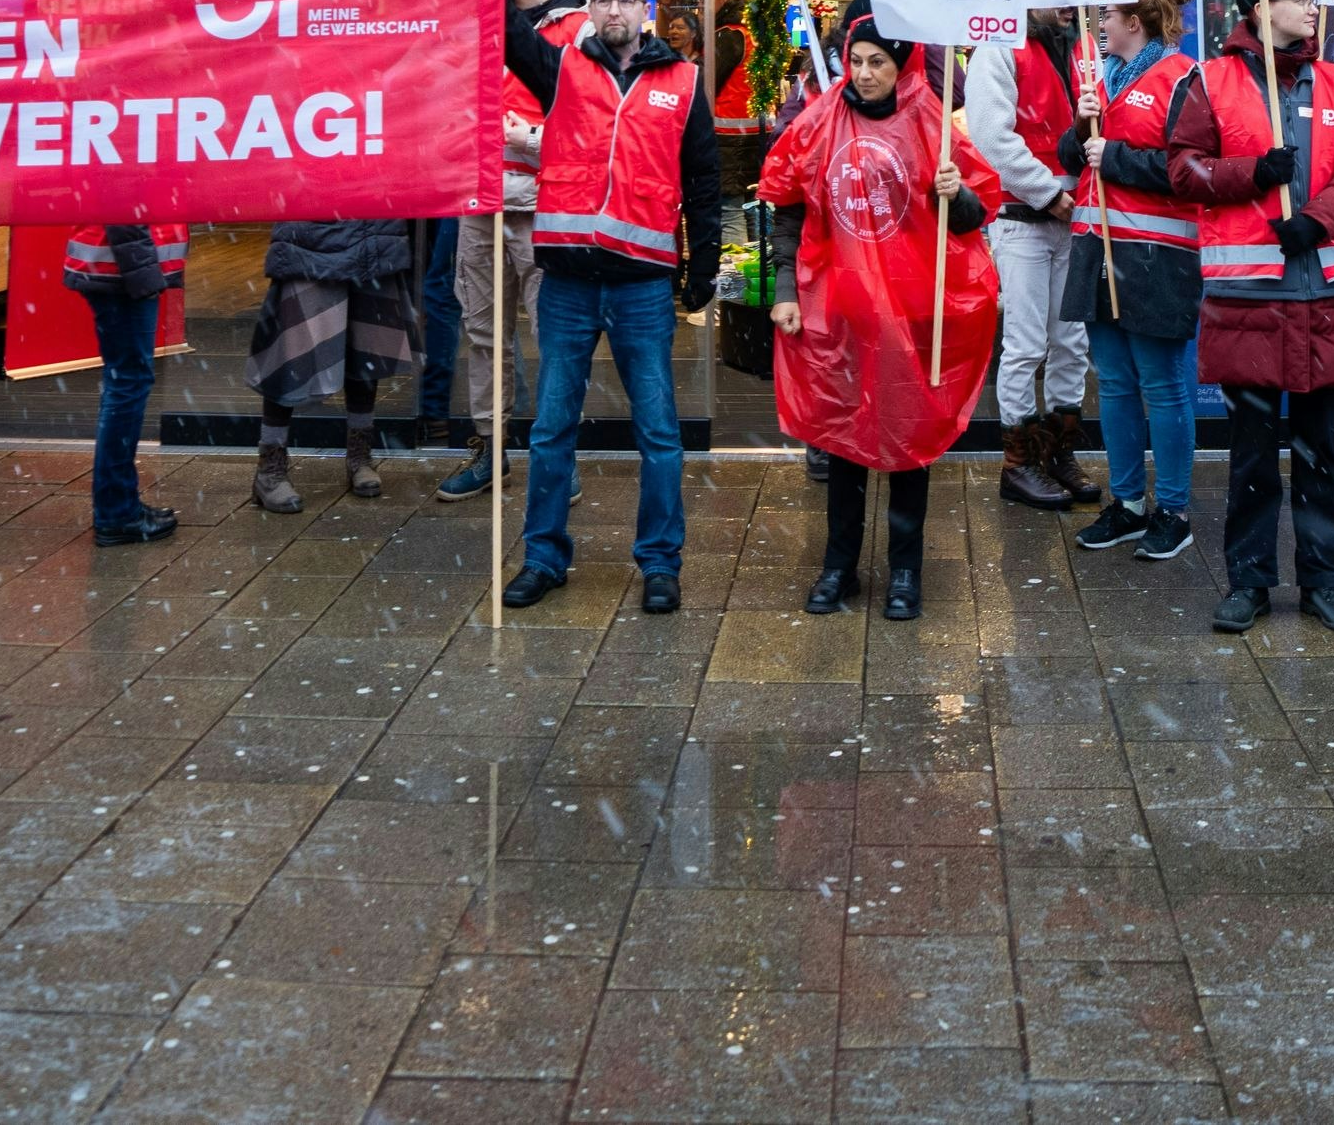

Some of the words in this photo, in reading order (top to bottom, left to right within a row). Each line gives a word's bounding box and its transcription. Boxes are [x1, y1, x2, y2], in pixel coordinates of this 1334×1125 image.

[308, 7, 360, 21] MEINE
[307, 19, 440, 37] GEWERKSCHAFT
[968, 16, 1018, 42] gpa
[1078, 59, 1096, 73] ga
[648, 89, 680, 108] gpa
[1124, 89, 1155, 107] gpa
[874, 205, 892, 216] gpa
